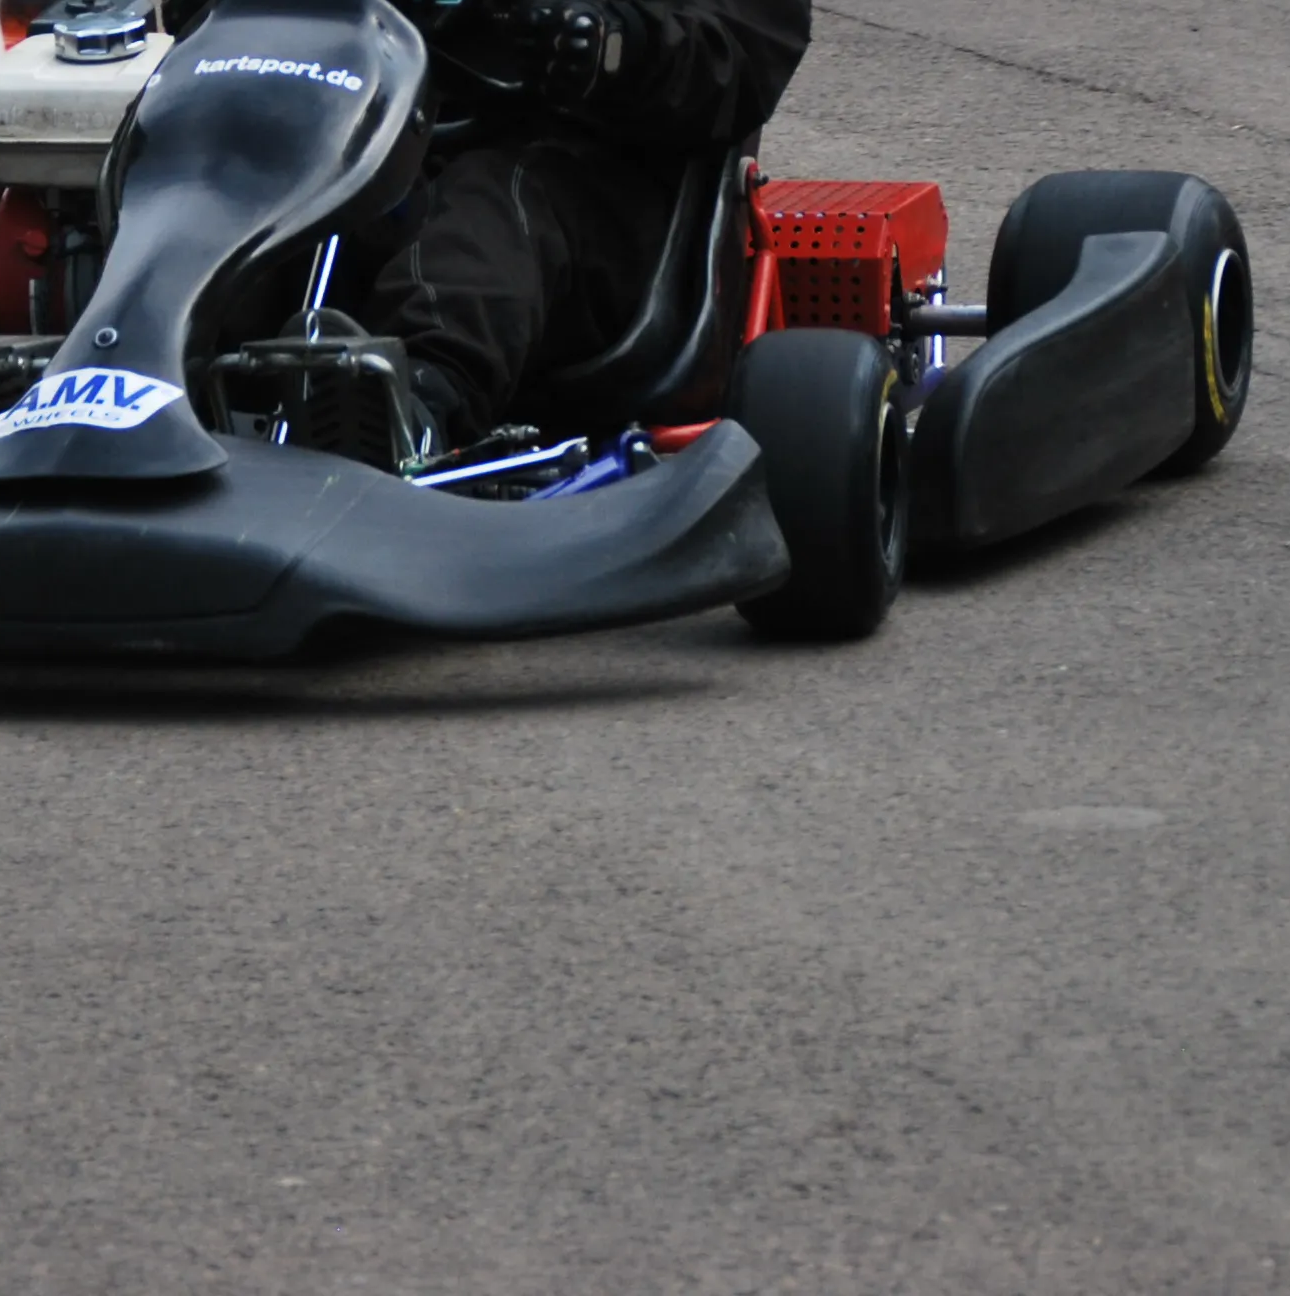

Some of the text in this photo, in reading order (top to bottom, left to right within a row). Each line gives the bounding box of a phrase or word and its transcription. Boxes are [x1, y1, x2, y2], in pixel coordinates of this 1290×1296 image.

[194, 55, 363, 92] kartsport.de
[3, 374, 157, 421] A.M.V.
[13, 406, 125, 429] WHEELS
